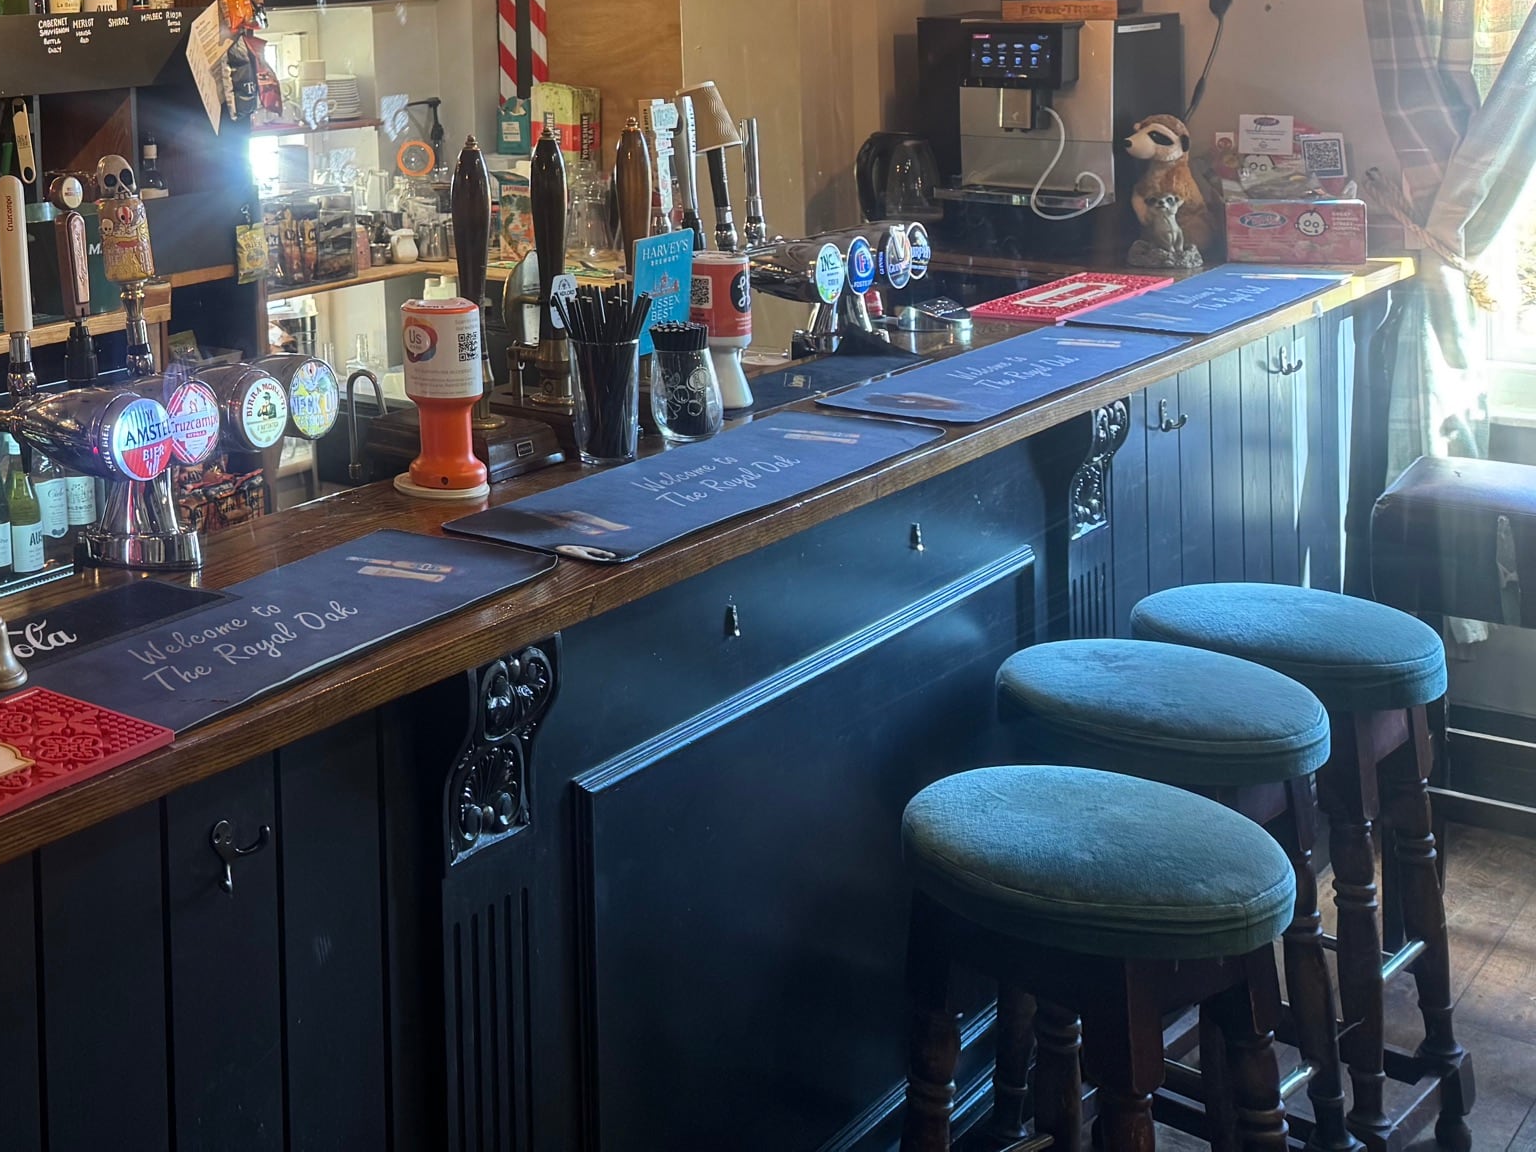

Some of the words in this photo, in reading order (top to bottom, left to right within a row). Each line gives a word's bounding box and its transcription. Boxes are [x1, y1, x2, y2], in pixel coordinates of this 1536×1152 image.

[38, 17, 68, 30] CABERNET
[72, 17, 95, 29] MERLOT
[107, 16, 130, 28] SHIRAZ
[140, 11, 164, 22] MALBEC
[165, 10, 183, 19] RIOJA
[581, 114, 589, 160] YORKSHIRE
[6, 194, 14, 232] Cruzcampo
[642, 238, 689, 261] HARVEY'S
[651, 294, 680, 310] USSEX
[651, 307, 674, 322] BEST
[408, 329, 422, 345] Us
[972, 378, 1016, 390] The
[246, 387, 263, 417] BIRRA
[125, 418, 172, 447] AMSTEL
[142, 443, 165, 462] BIER
[630, 461, 717, 493] Welcome
[714, 454, 739, 466] to
[655, 490, 708, 508] The
[699, 466, 763, 493] Royal
[750, 454, 802, 474] Oak
[128, 615, 248, 668] Welcome
[251, 601, 282, 618] to
[142, 661, 213, 692] The
[213, 618, 299, 668] Royal
[293, 598, 360, 631] Oak
